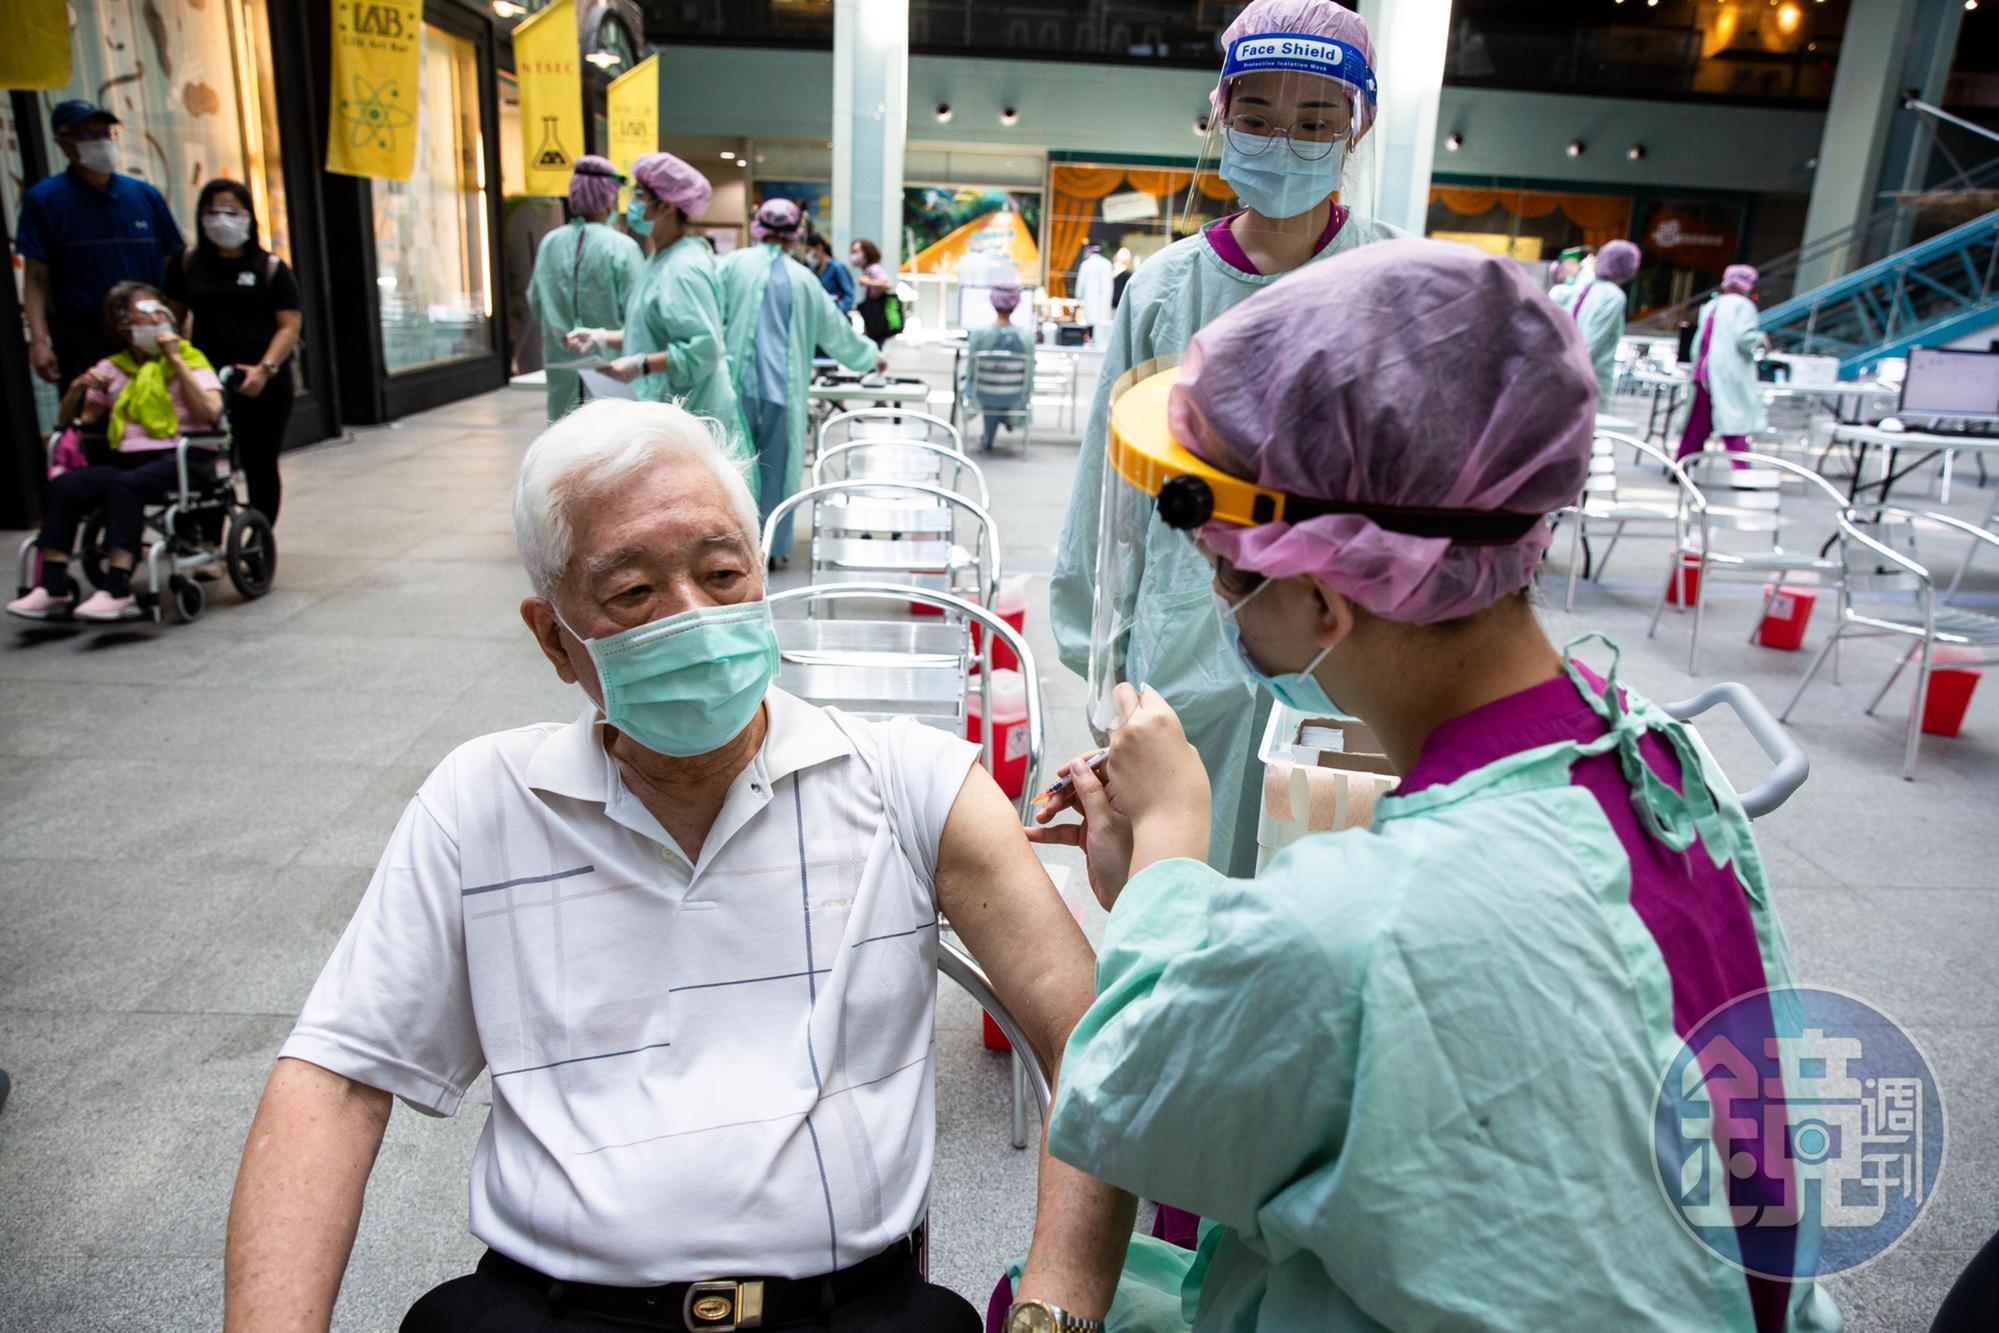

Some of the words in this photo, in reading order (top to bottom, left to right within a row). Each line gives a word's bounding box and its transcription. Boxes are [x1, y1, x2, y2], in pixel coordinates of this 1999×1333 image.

[354, 2, 403, 38] LAB
[1242, 45, 1275, 57] Face
[1282, 42, 1336, 61] Shield
[1310, 63, 1327, 72] Mask
